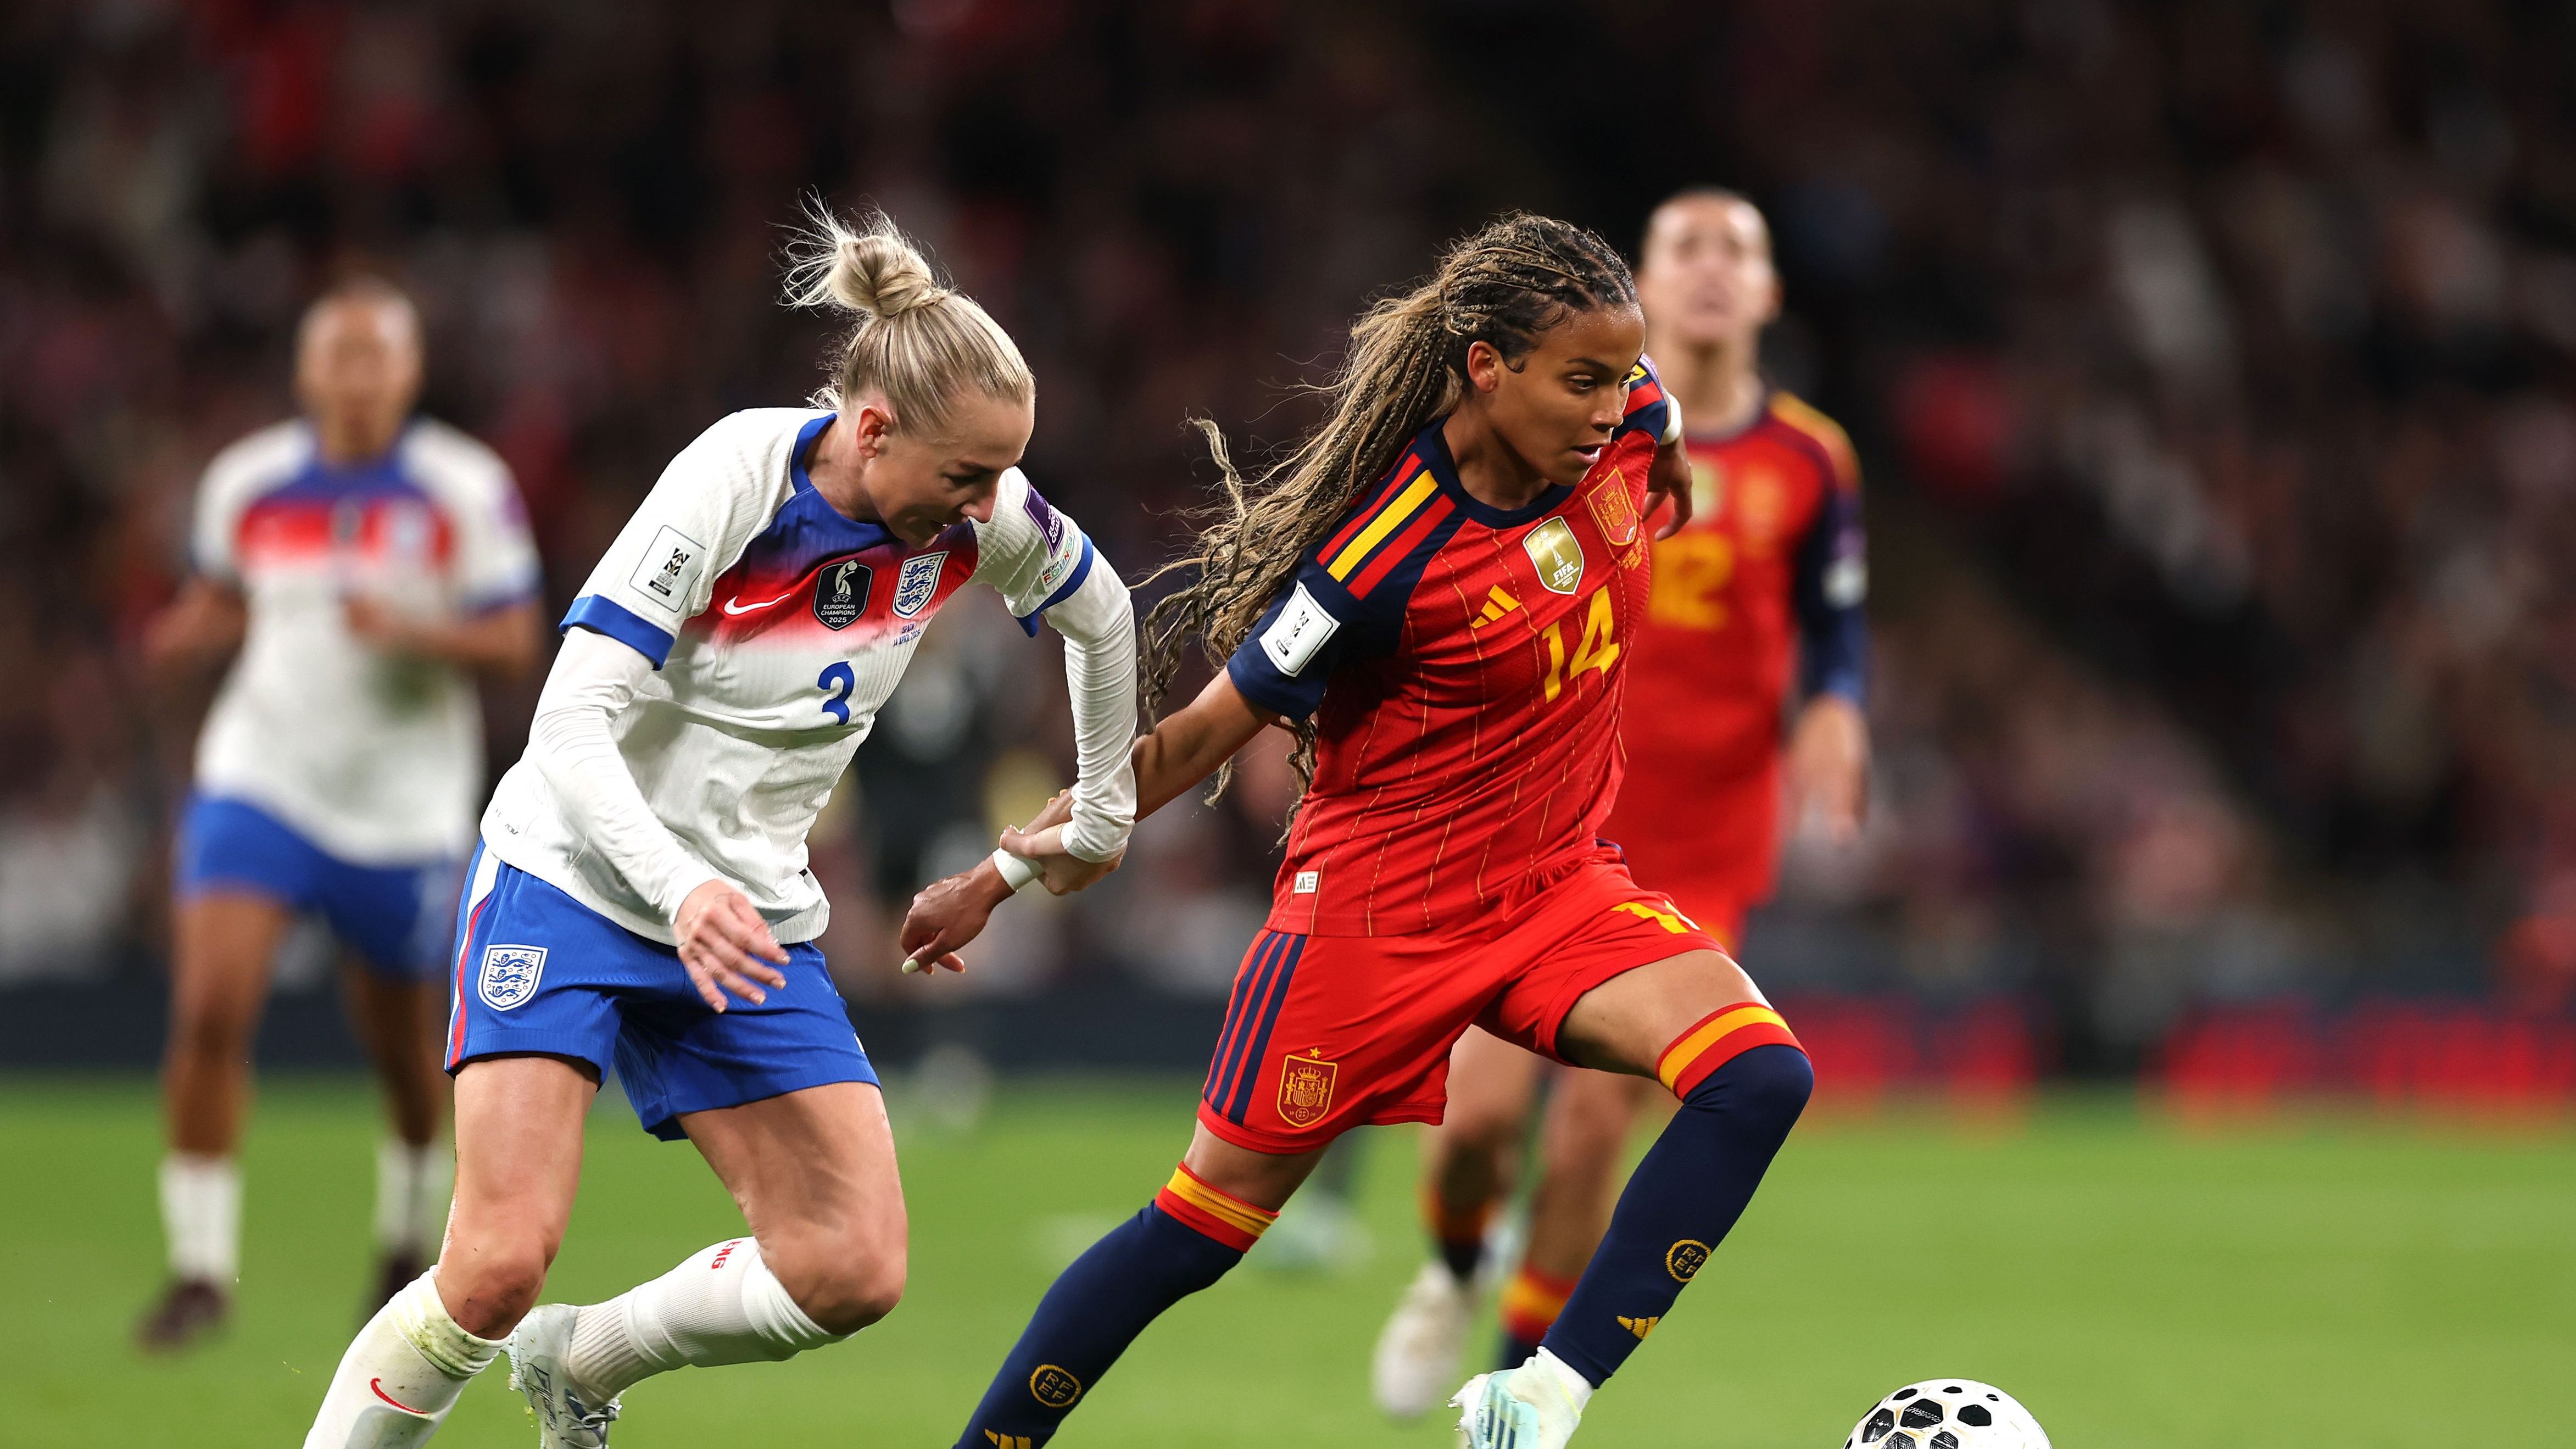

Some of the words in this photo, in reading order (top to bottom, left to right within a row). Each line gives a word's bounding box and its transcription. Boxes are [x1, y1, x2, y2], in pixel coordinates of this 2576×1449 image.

[1042, 561, 1060, 576] UEFA
[1553, 562, 1574, 582] FIFA
[1542, 584, 1620, 704] 14
[817, 661, 855, 726] 3
